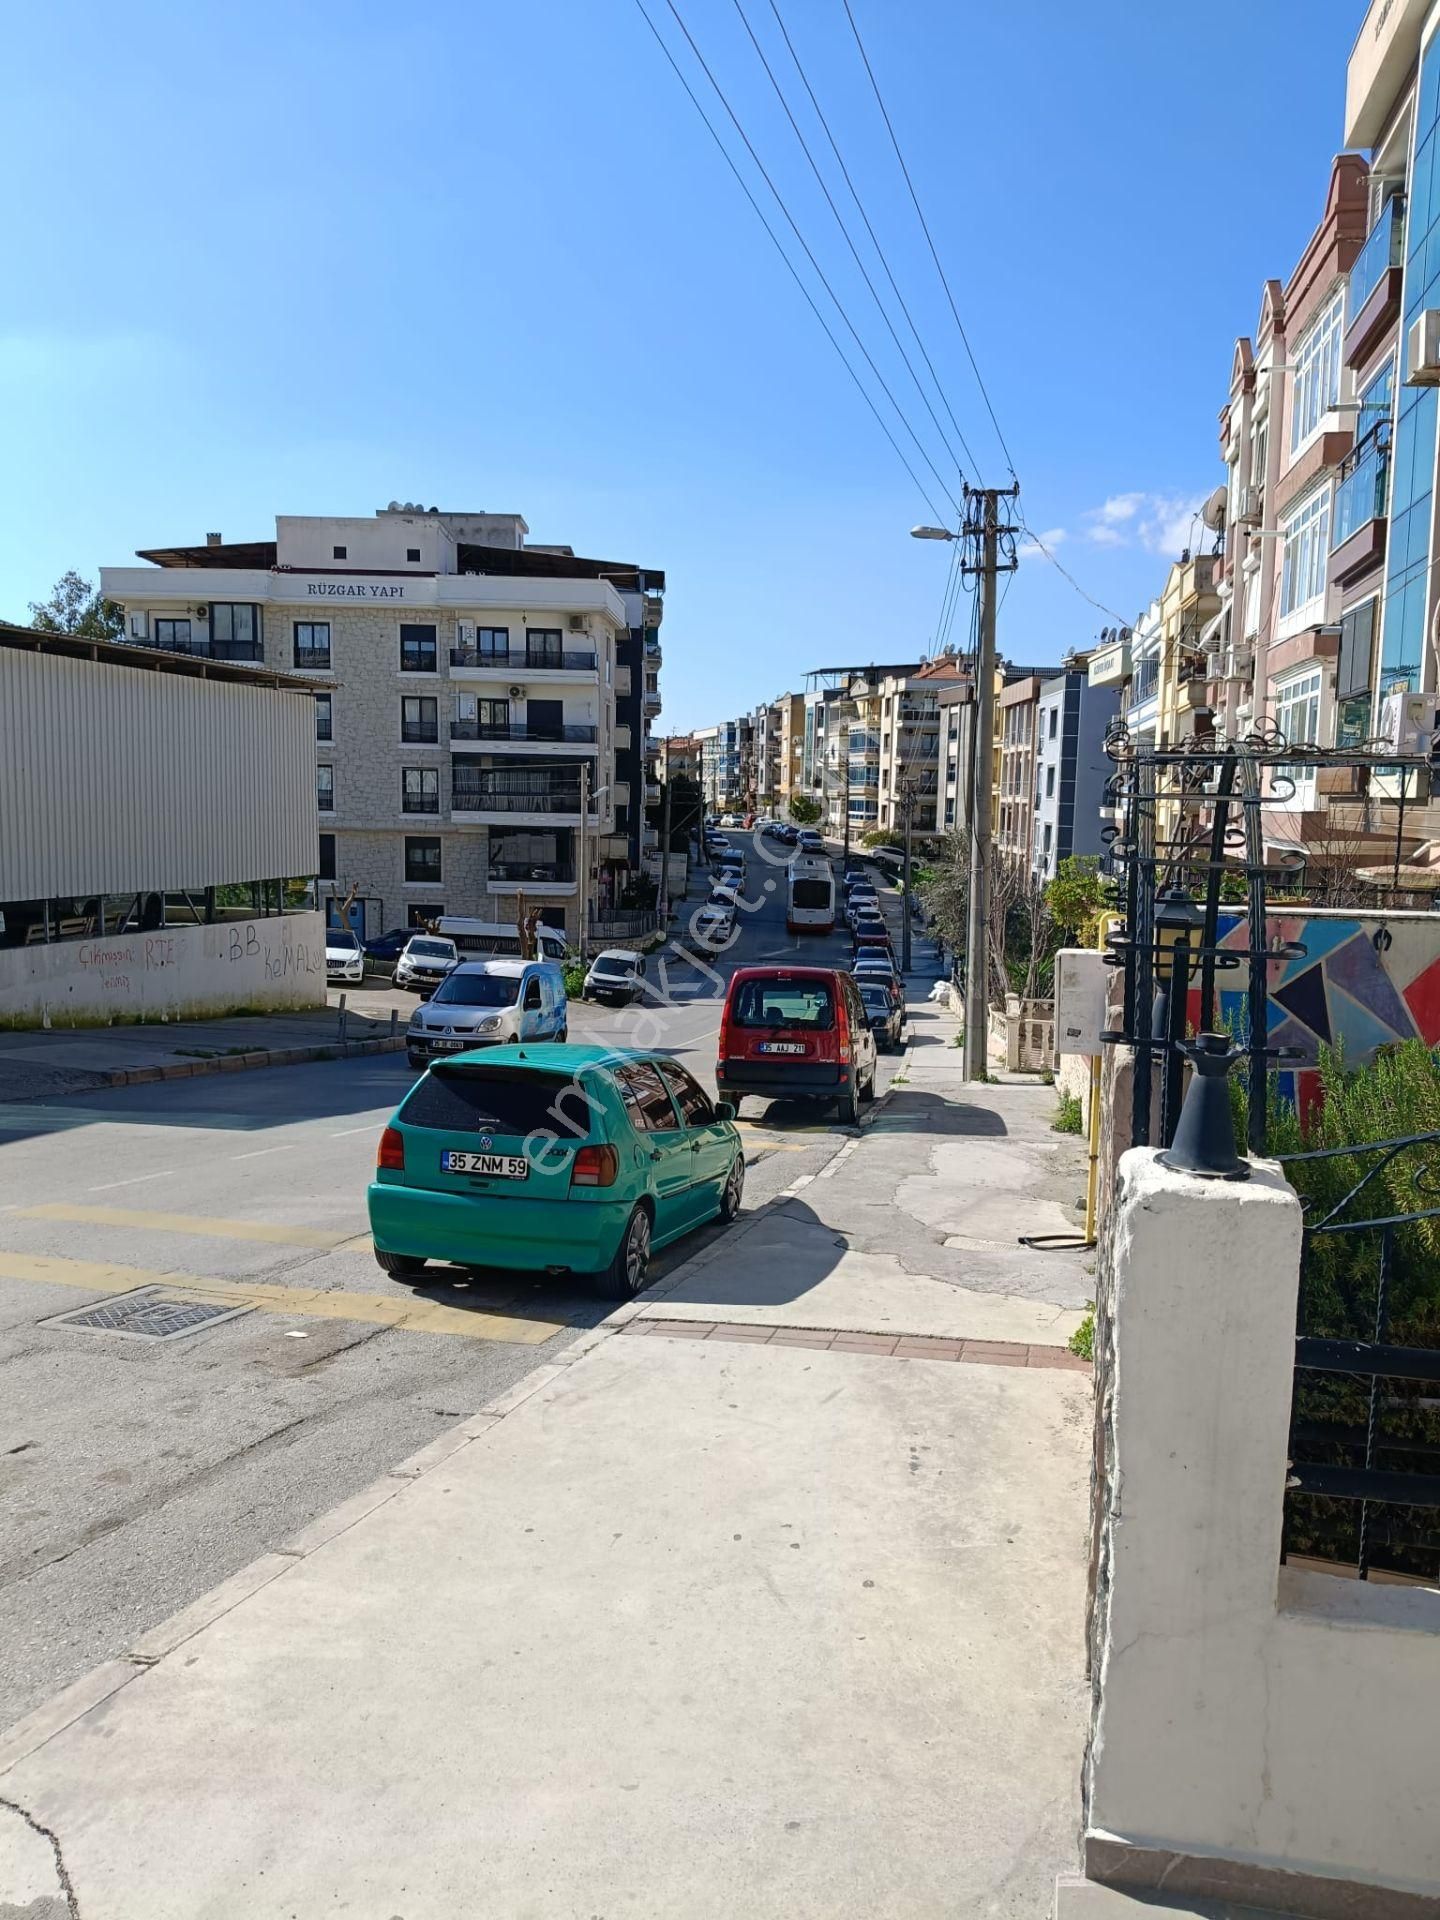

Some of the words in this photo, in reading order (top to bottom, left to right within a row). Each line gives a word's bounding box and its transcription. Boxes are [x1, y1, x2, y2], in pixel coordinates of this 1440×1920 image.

[307, 581, 366, 596] RÜZGAR
[369, 586, 404, 598] YAPI
[449, 1153, 466, 1169] 35
[471, 1155, 503, 1173] ZNM
[508, 1158, 526, 1174] 59
